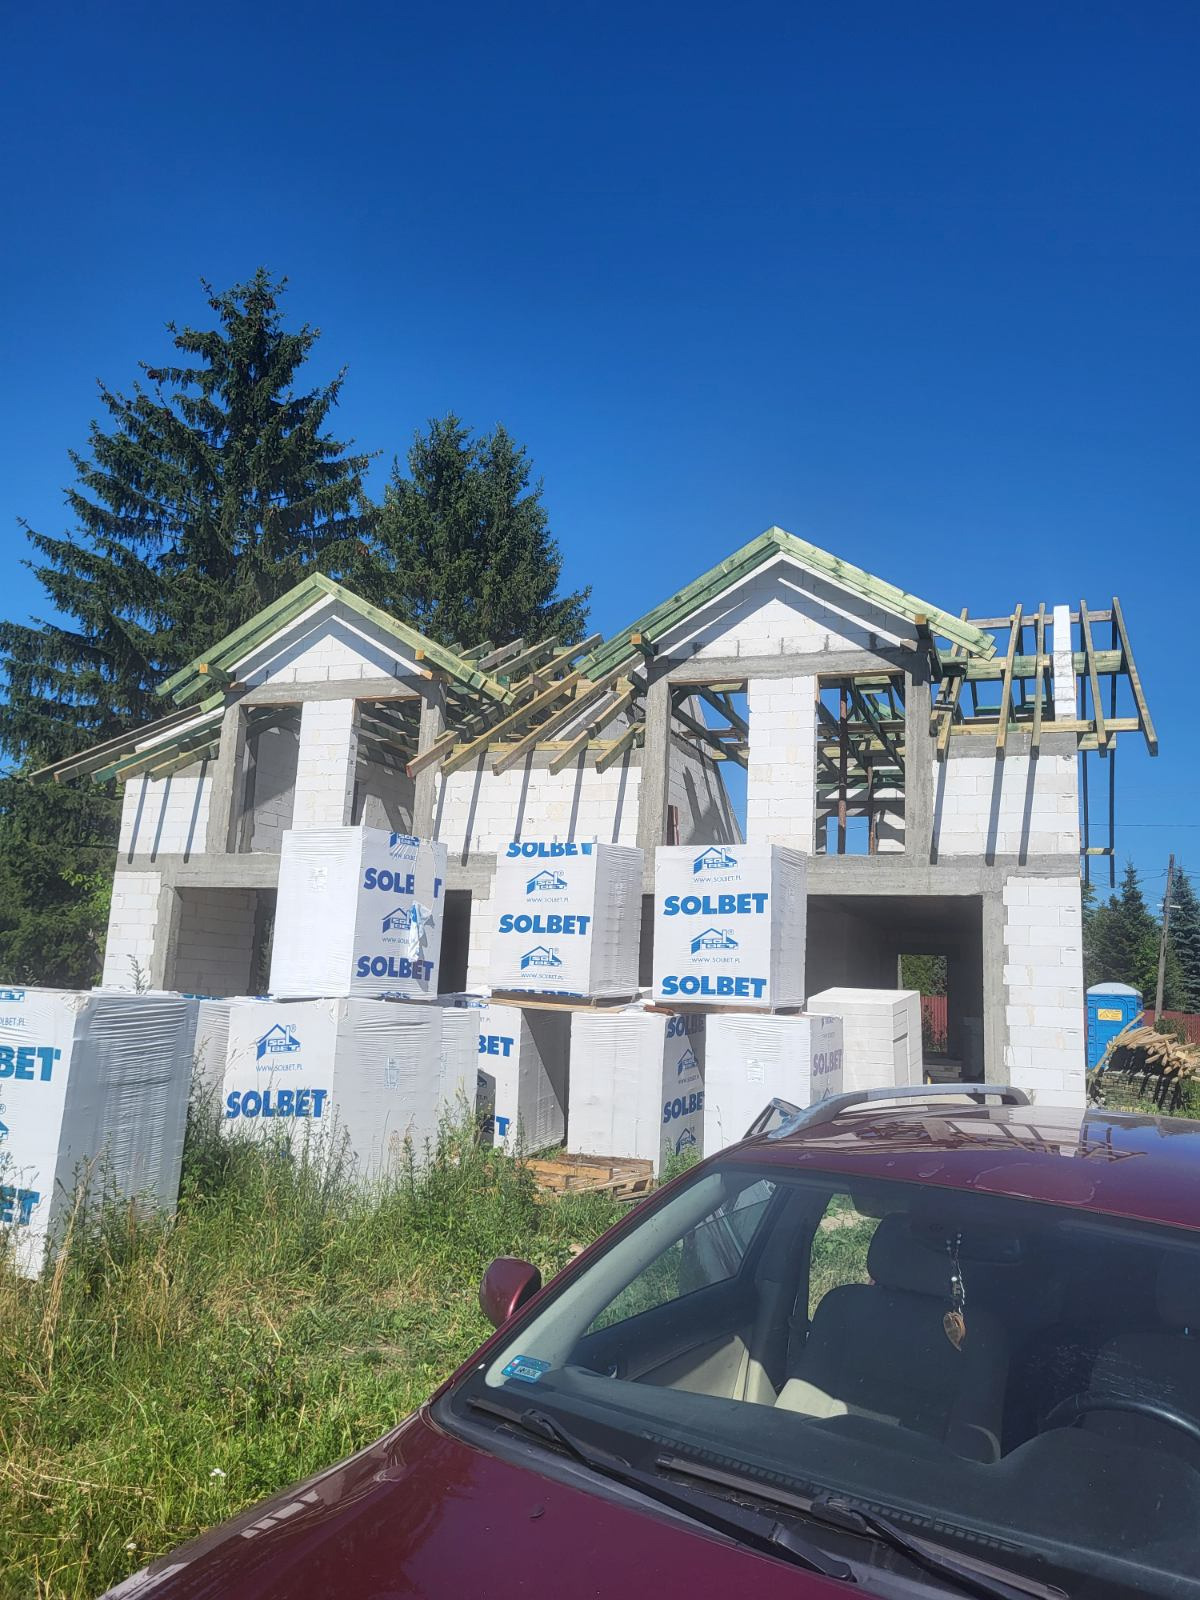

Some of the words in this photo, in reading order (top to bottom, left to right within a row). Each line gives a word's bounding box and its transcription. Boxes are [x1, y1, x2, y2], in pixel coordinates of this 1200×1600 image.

[363, 867, 442, 899] SOLBT
[663, 893, 768, 916] SOLBET
[499, 914, 590, 935] SOLBET
[356, 955, 434, 981] SOLBET
[662, 975, 767, 998] SOLBET
[813, 1049, 842, 1076] SOLBET
[226, 1089, 328, 1119] SOLBET
[663, 1090, 705, 1124] SOLBE
